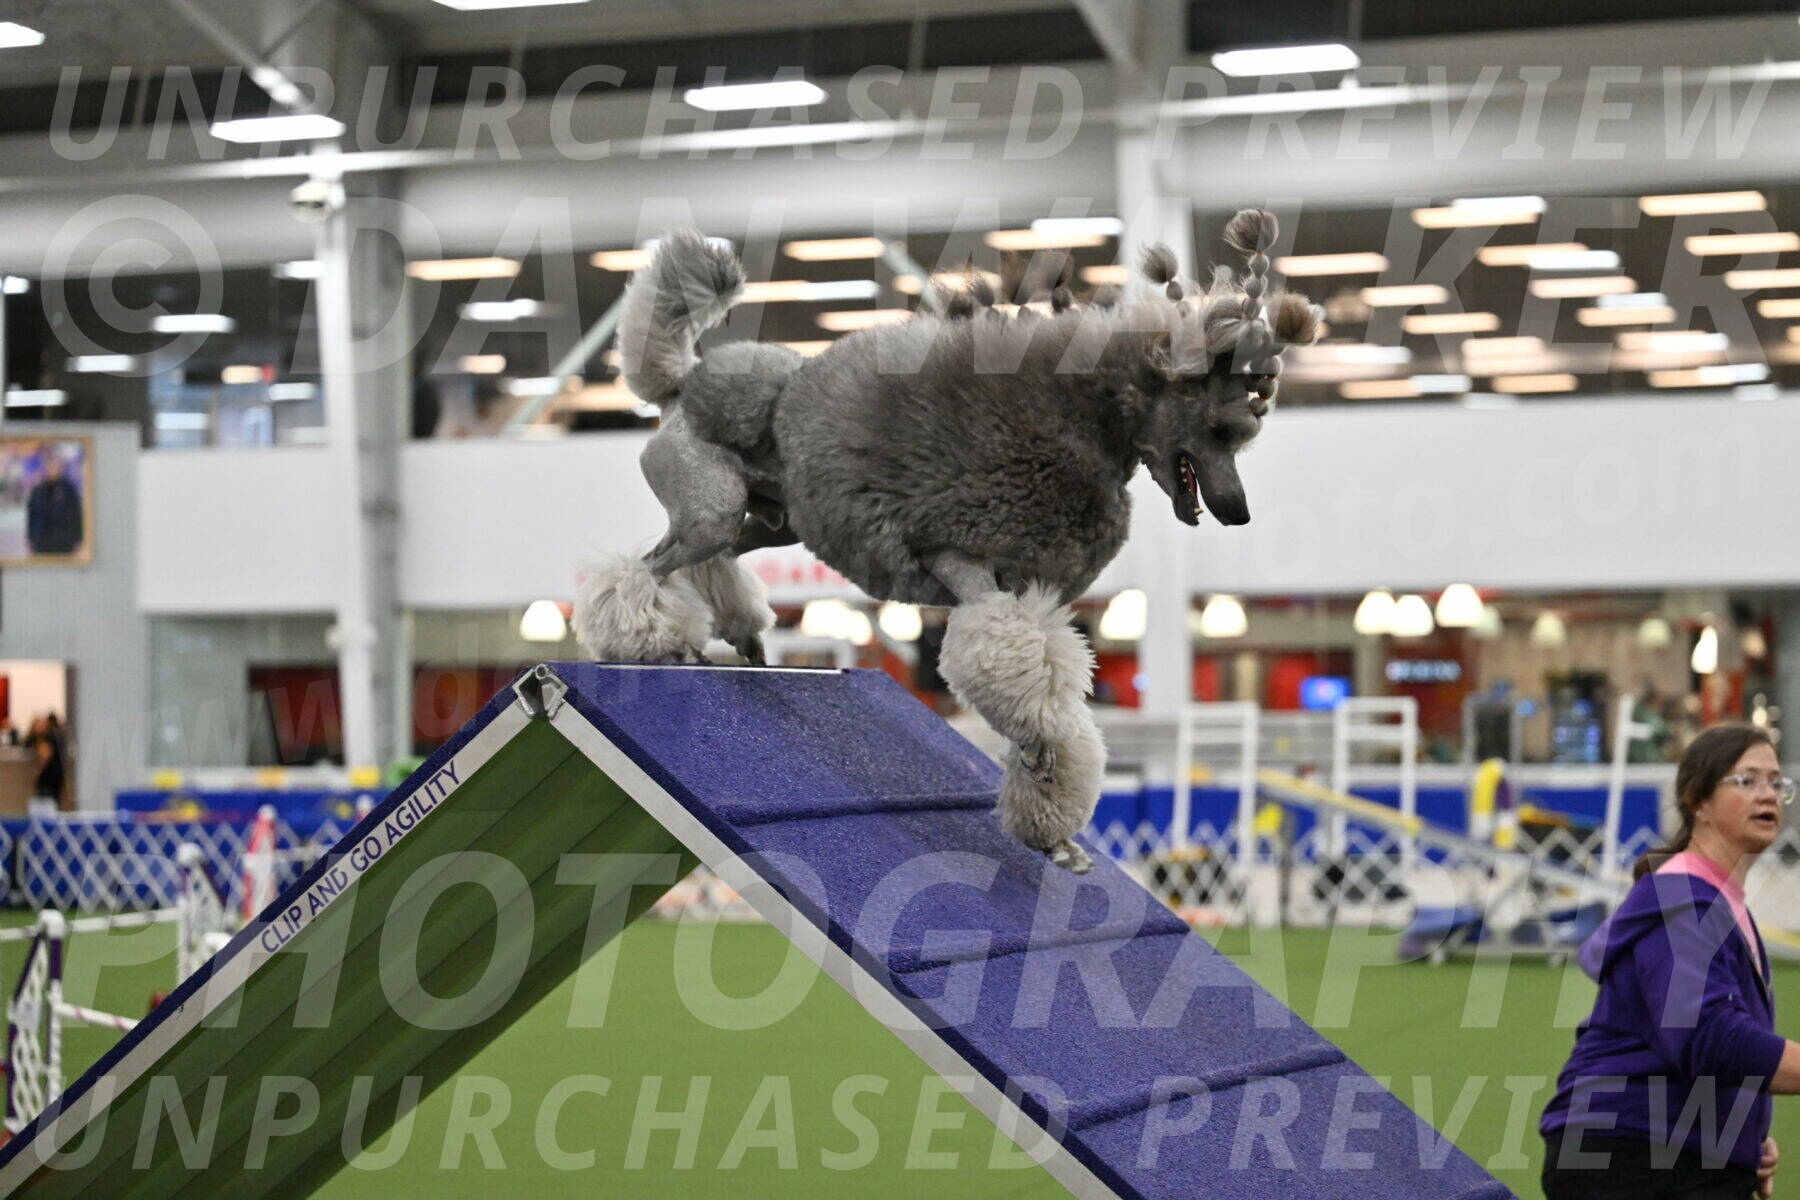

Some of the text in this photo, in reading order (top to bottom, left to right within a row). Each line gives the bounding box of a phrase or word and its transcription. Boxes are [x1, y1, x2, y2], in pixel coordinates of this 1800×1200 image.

[261, 760, 460, 953] CLIP AND GO AGILITY
